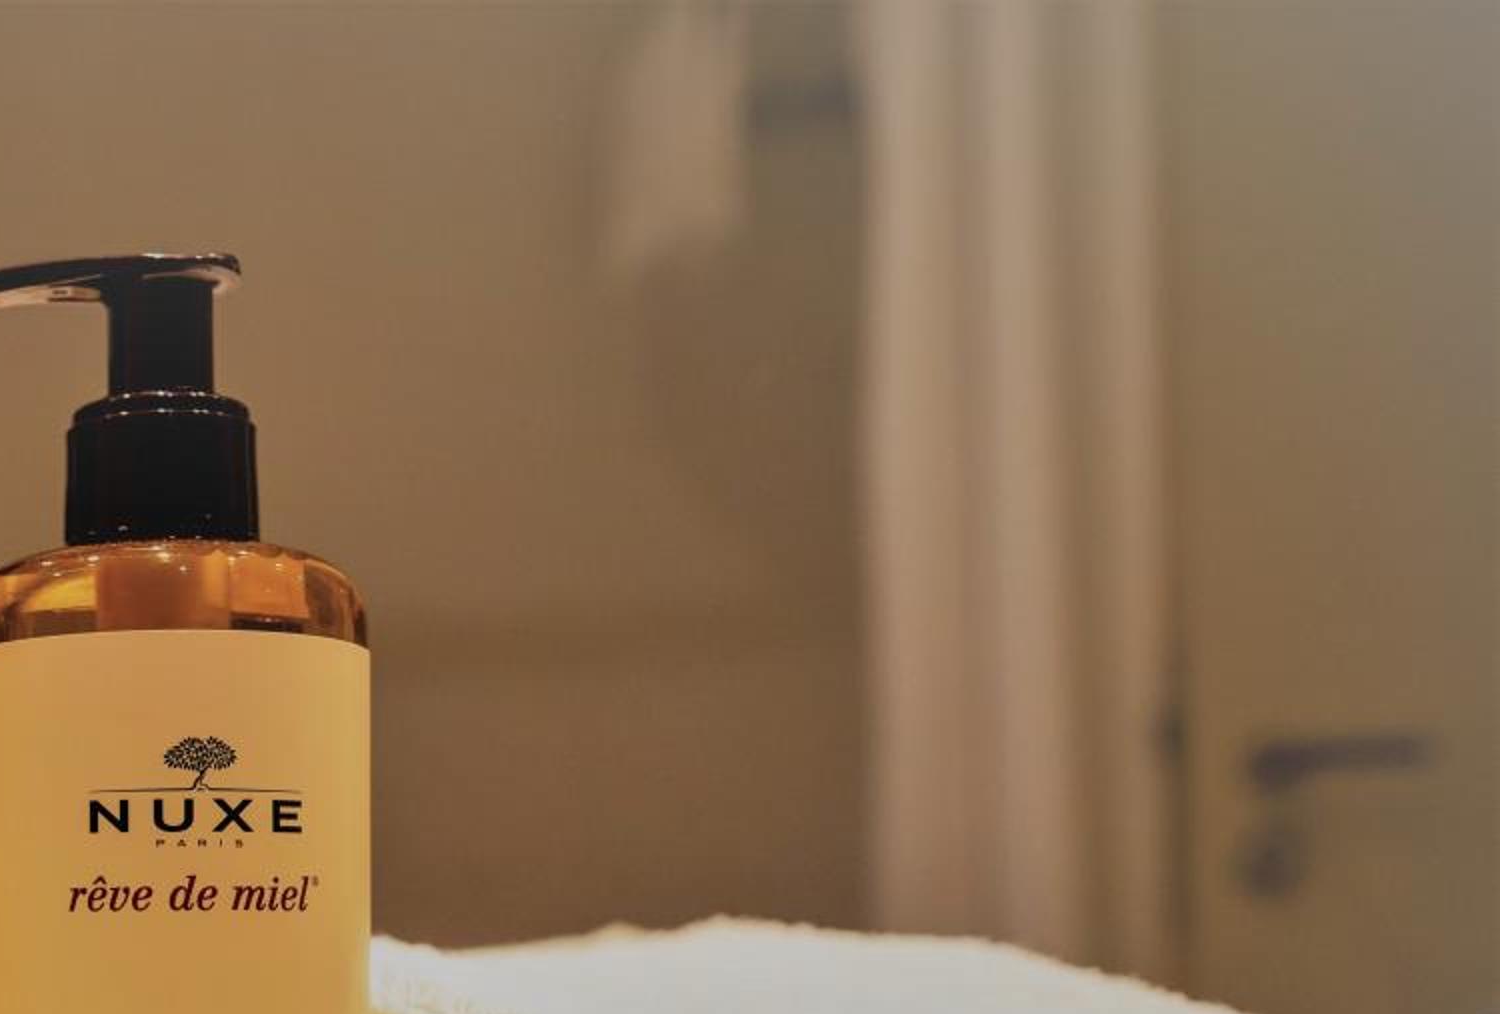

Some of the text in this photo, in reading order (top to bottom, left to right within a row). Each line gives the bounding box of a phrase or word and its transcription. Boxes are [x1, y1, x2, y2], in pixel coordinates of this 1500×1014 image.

[88, 797, 303, 834] NUXE
[155, 837, 244, 849] PARIS
[68, 875, 154, 913] rêve
[168, 874, 219, 912] de
